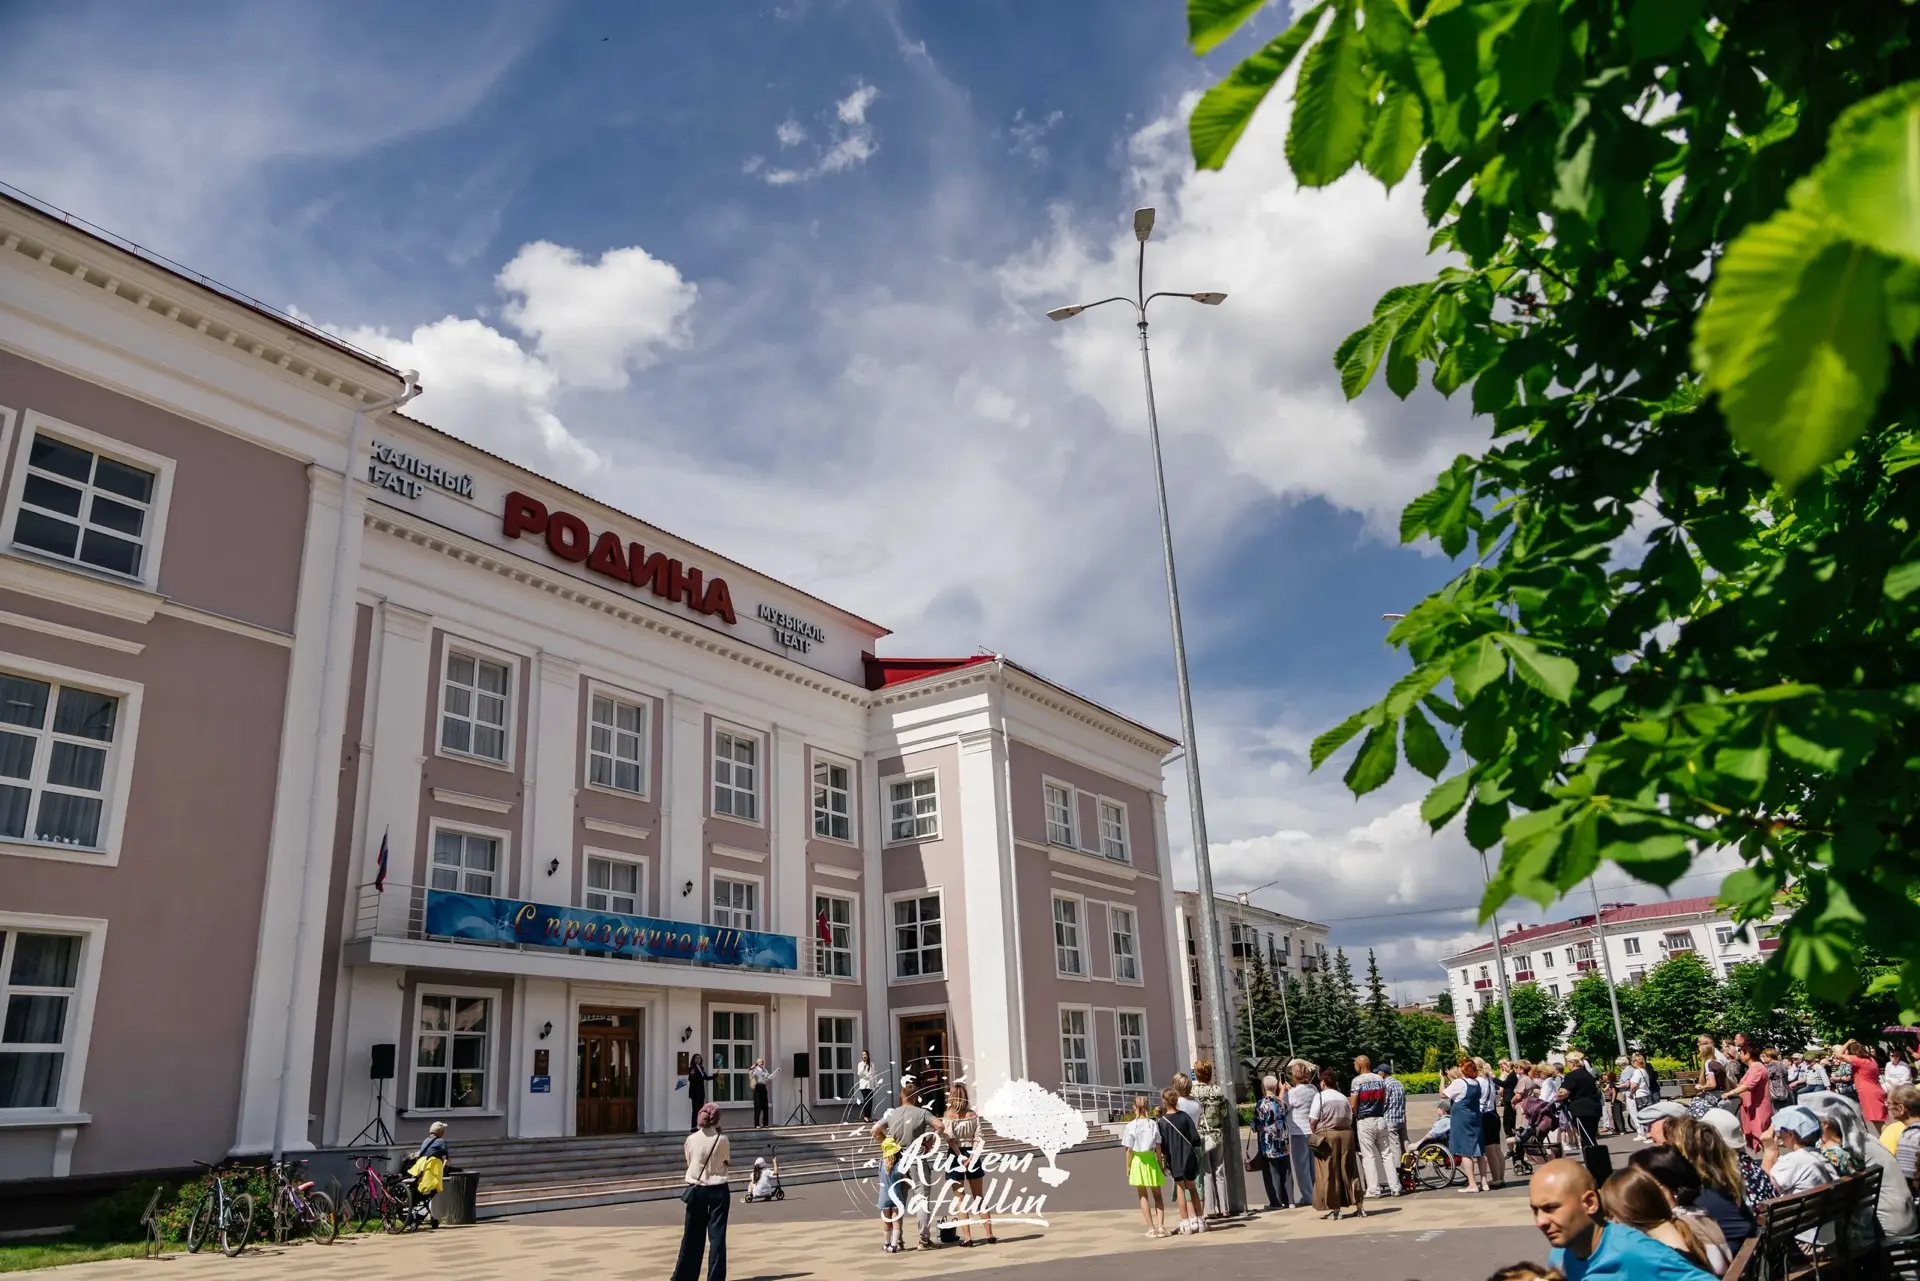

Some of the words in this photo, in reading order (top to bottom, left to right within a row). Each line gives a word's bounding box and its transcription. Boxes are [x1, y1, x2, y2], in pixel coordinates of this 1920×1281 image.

[503, 490, 737, 625] РОДИНА
[758, 603, 828, 643] МУЗЫКАЛЬ
[774, 628, 812, 654] ТЕАТР
[515, 904, 537, 935] С
[1361, 1081, 1385, 1091] RUSSI
